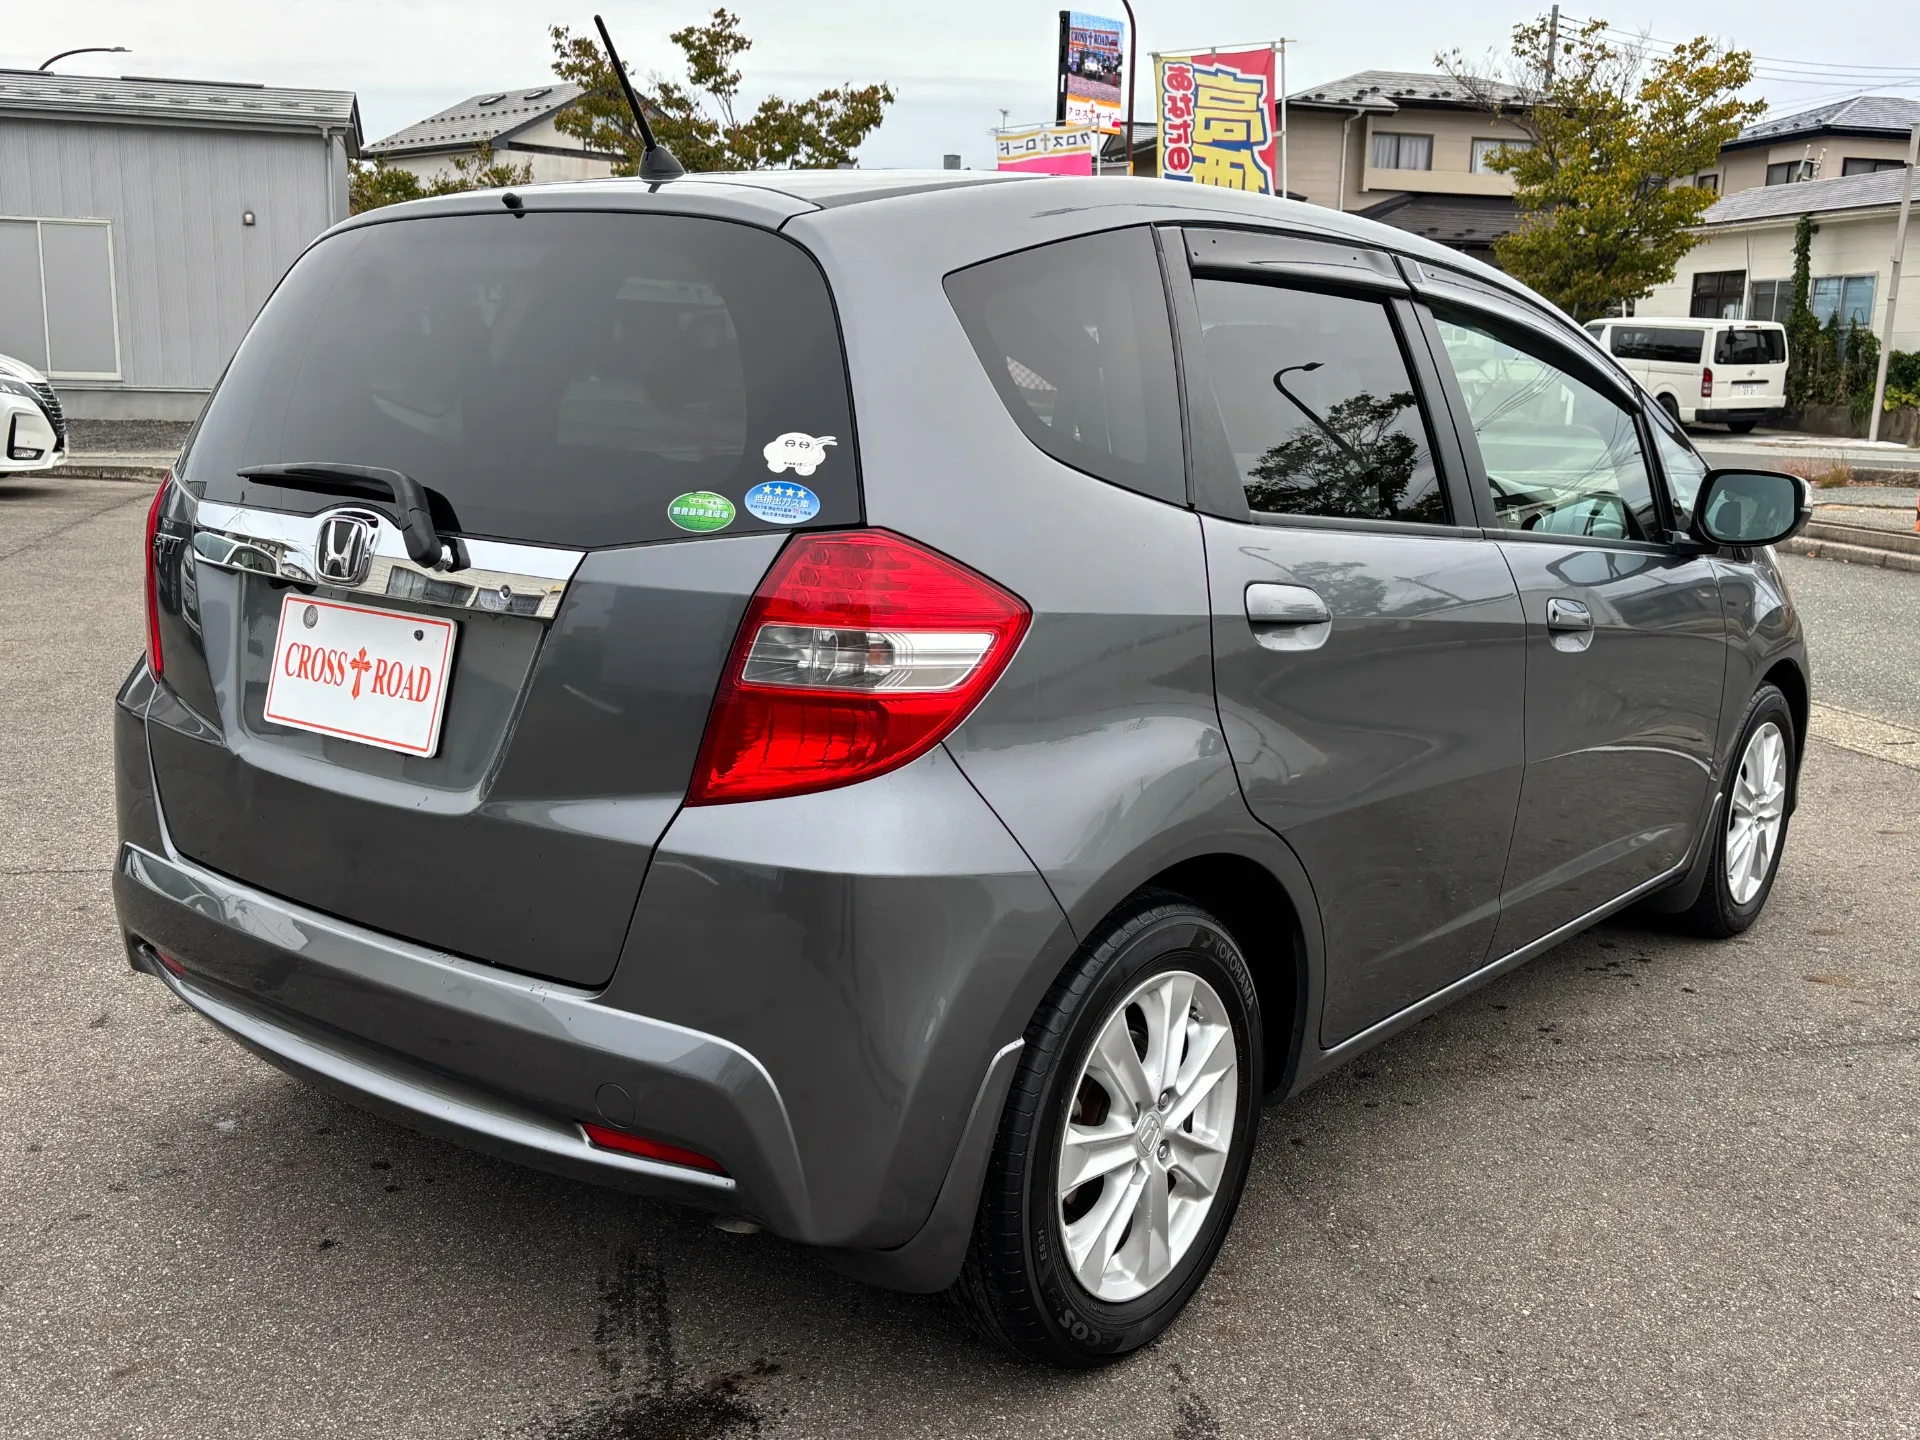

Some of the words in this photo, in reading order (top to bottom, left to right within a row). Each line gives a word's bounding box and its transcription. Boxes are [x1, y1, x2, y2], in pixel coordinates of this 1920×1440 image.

[1070, 30, 1088, 43] CROSS
[1094, 33, 1110, 47] ROAD
[1068, 106, 1088, 118] クロス
[284, 642, 348, 686] CROSS
[370, 658, 432, 702] ROAD
[1215, 938, 1254, 1010] YOKOHAMA
